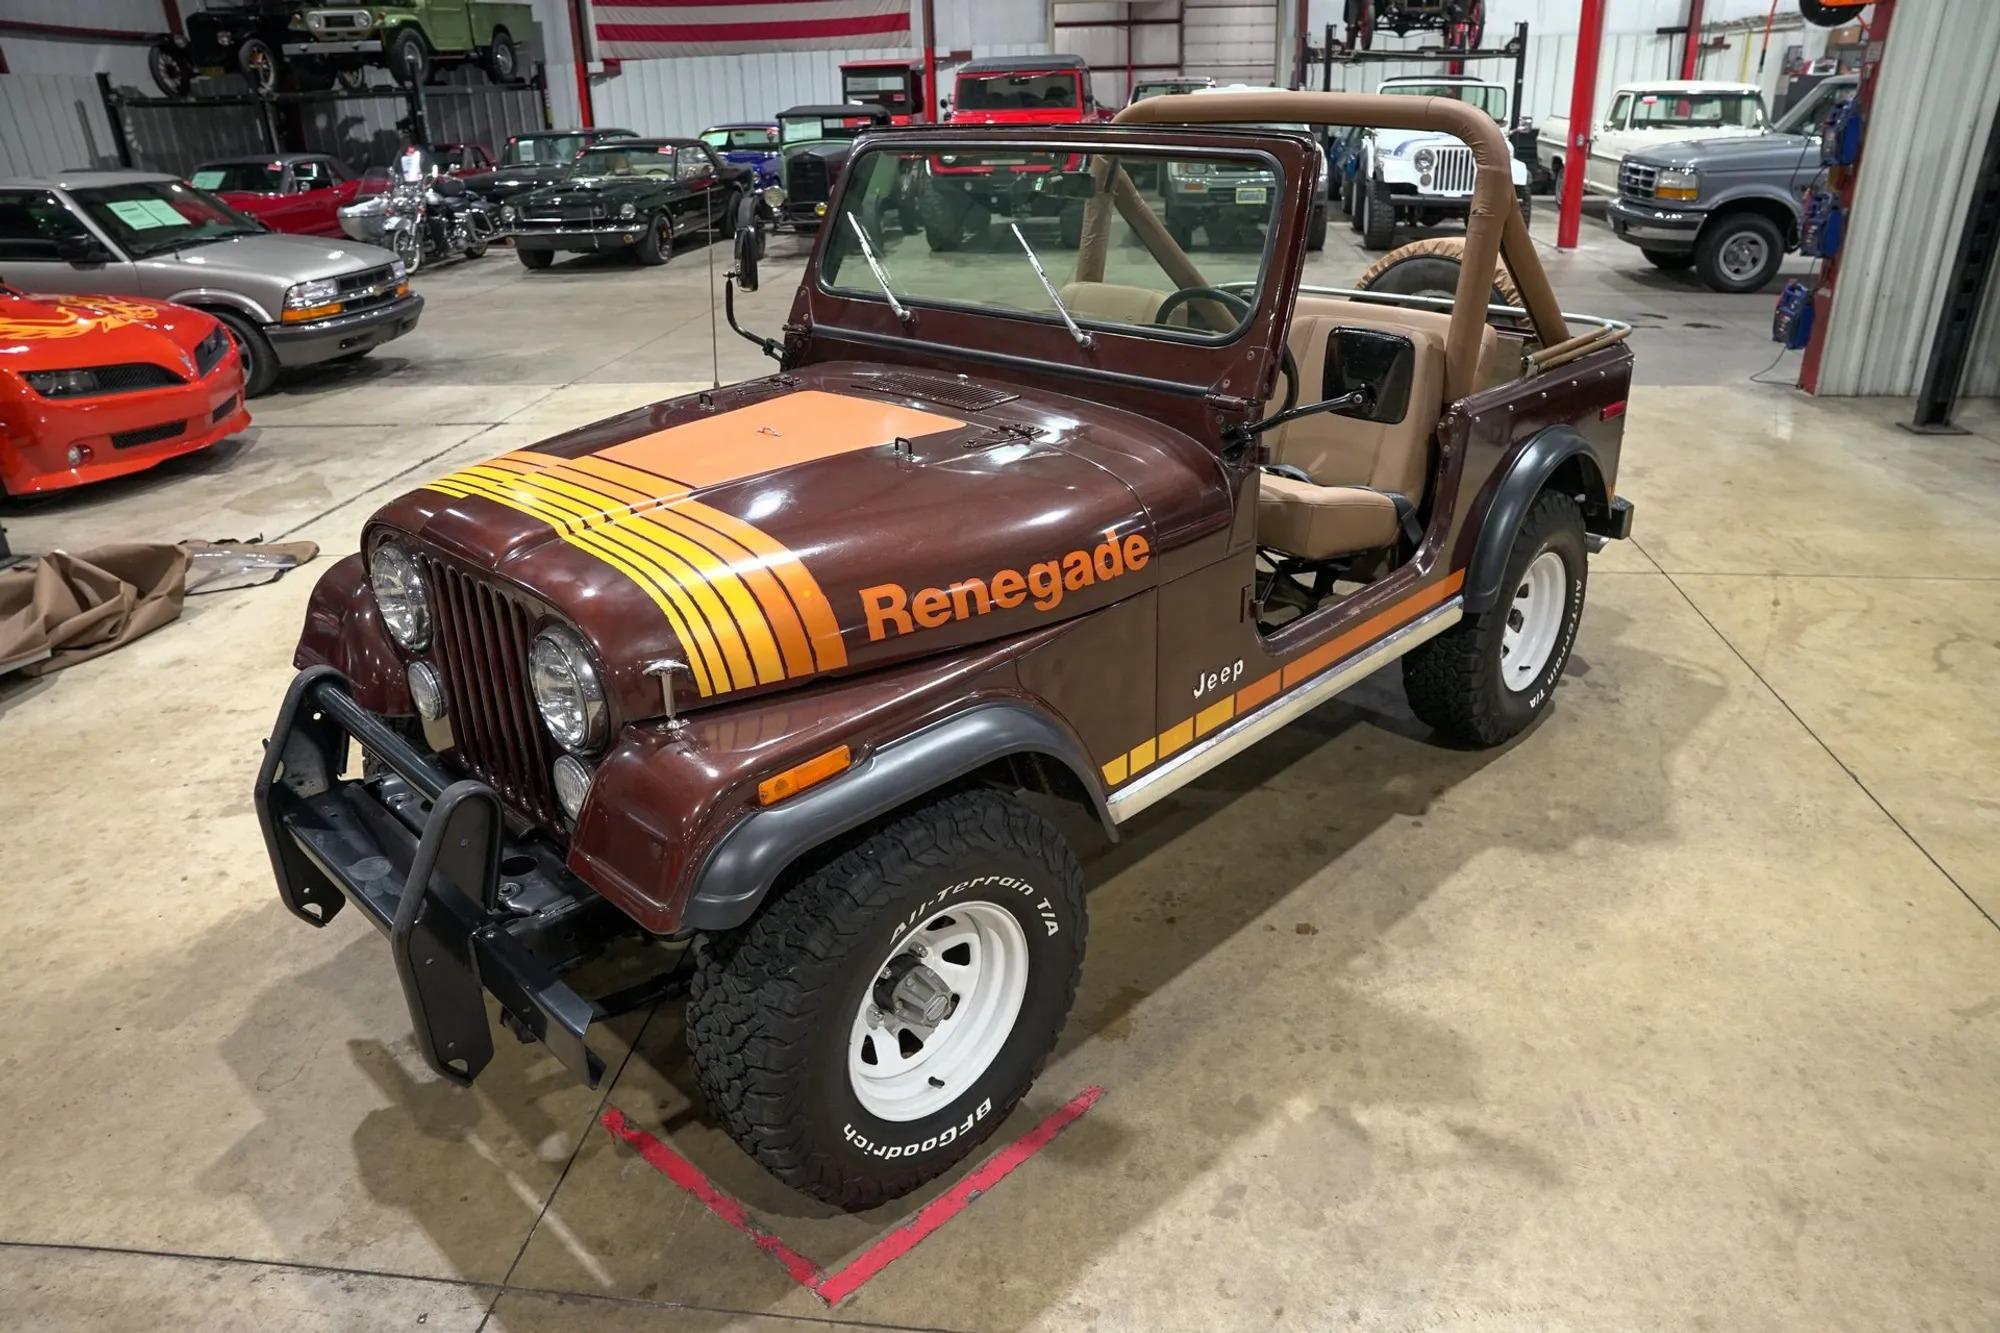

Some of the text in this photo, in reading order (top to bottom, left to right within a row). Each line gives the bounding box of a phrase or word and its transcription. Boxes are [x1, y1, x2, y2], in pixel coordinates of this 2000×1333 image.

[858, 529, 1150, 642] Renegade
[1545, 579, 1582, 685] All-Terrain
[1193, 658, 1245, 699] Jeep
[889, 874, 1035, 945] All-Terrain
[843, 1097, 992, 1160] BFGoodrich
